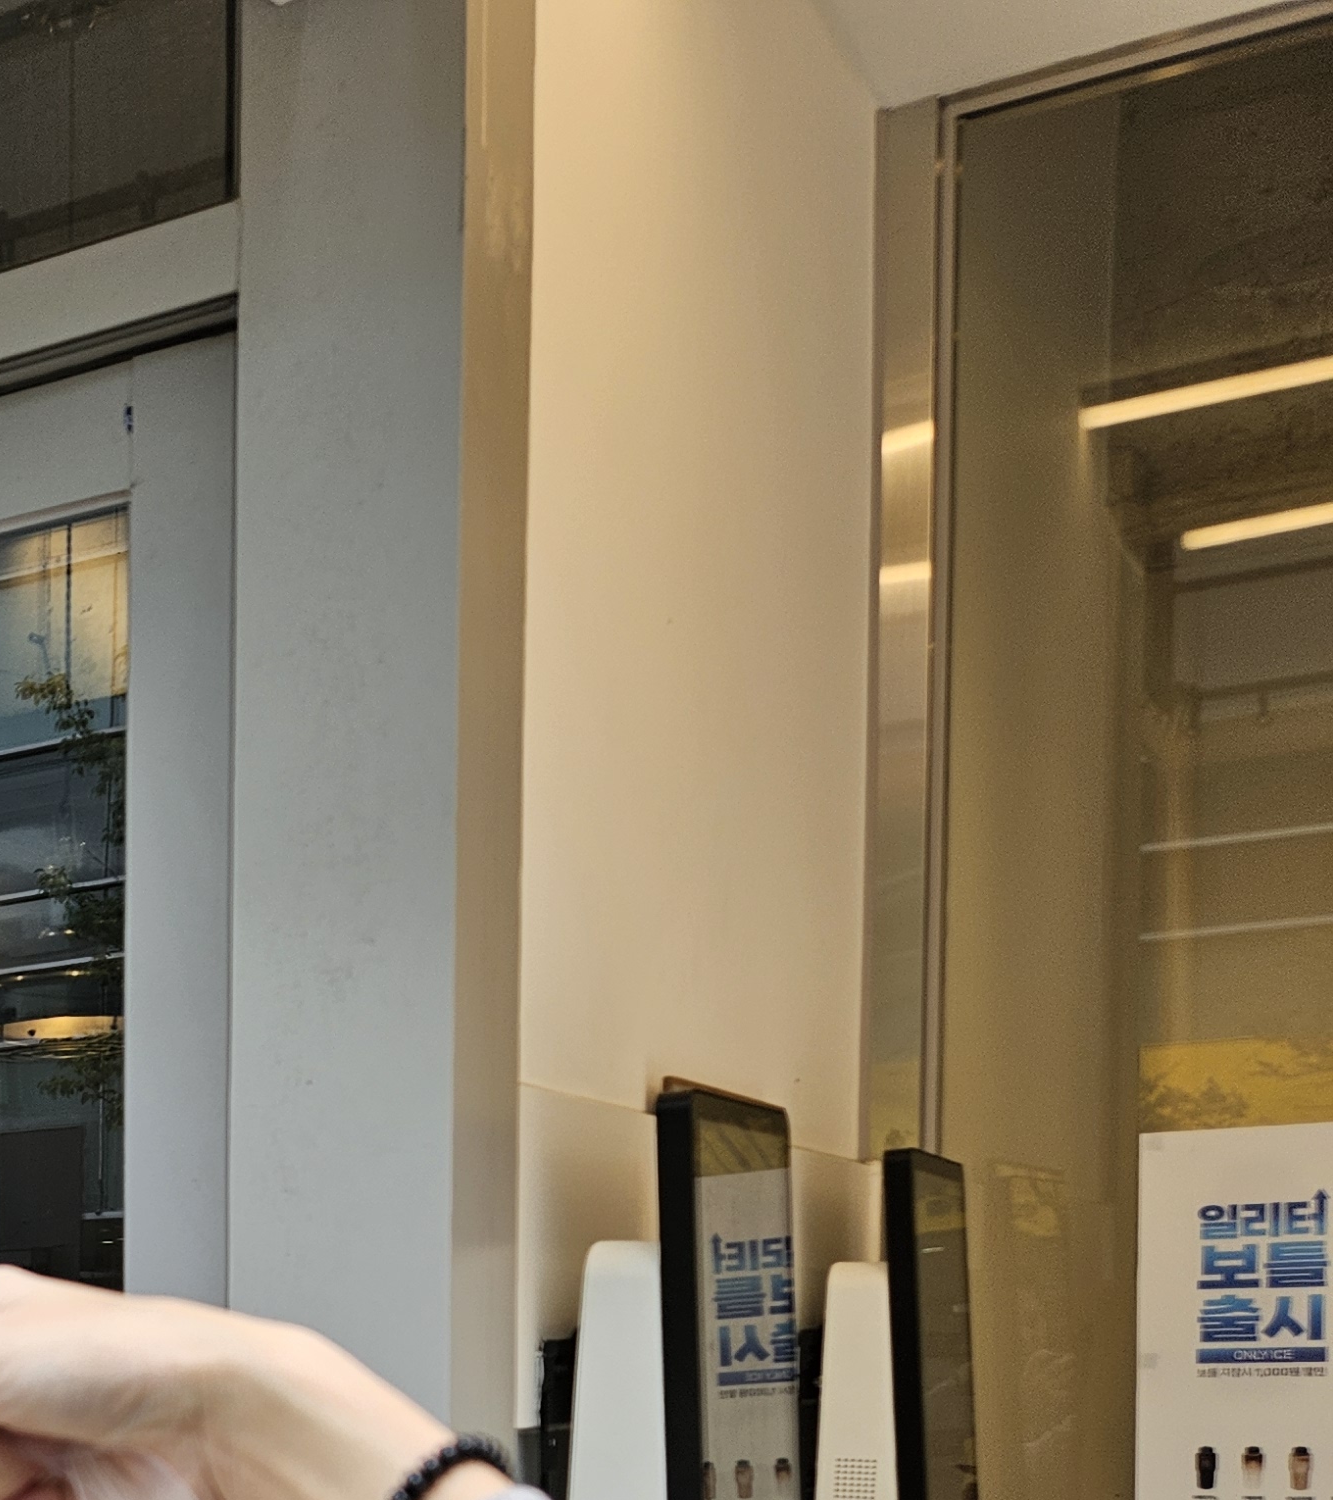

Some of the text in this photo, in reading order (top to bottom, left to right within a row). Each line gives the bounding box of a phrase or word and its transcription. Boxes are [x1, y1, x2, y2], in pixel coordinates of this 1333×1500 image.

[1197, 1189, 1329, 1239] 일리터
[1197, 1241, 1329, 1289] 보틀
[1197, 1294, 1325, 1342] 출시
